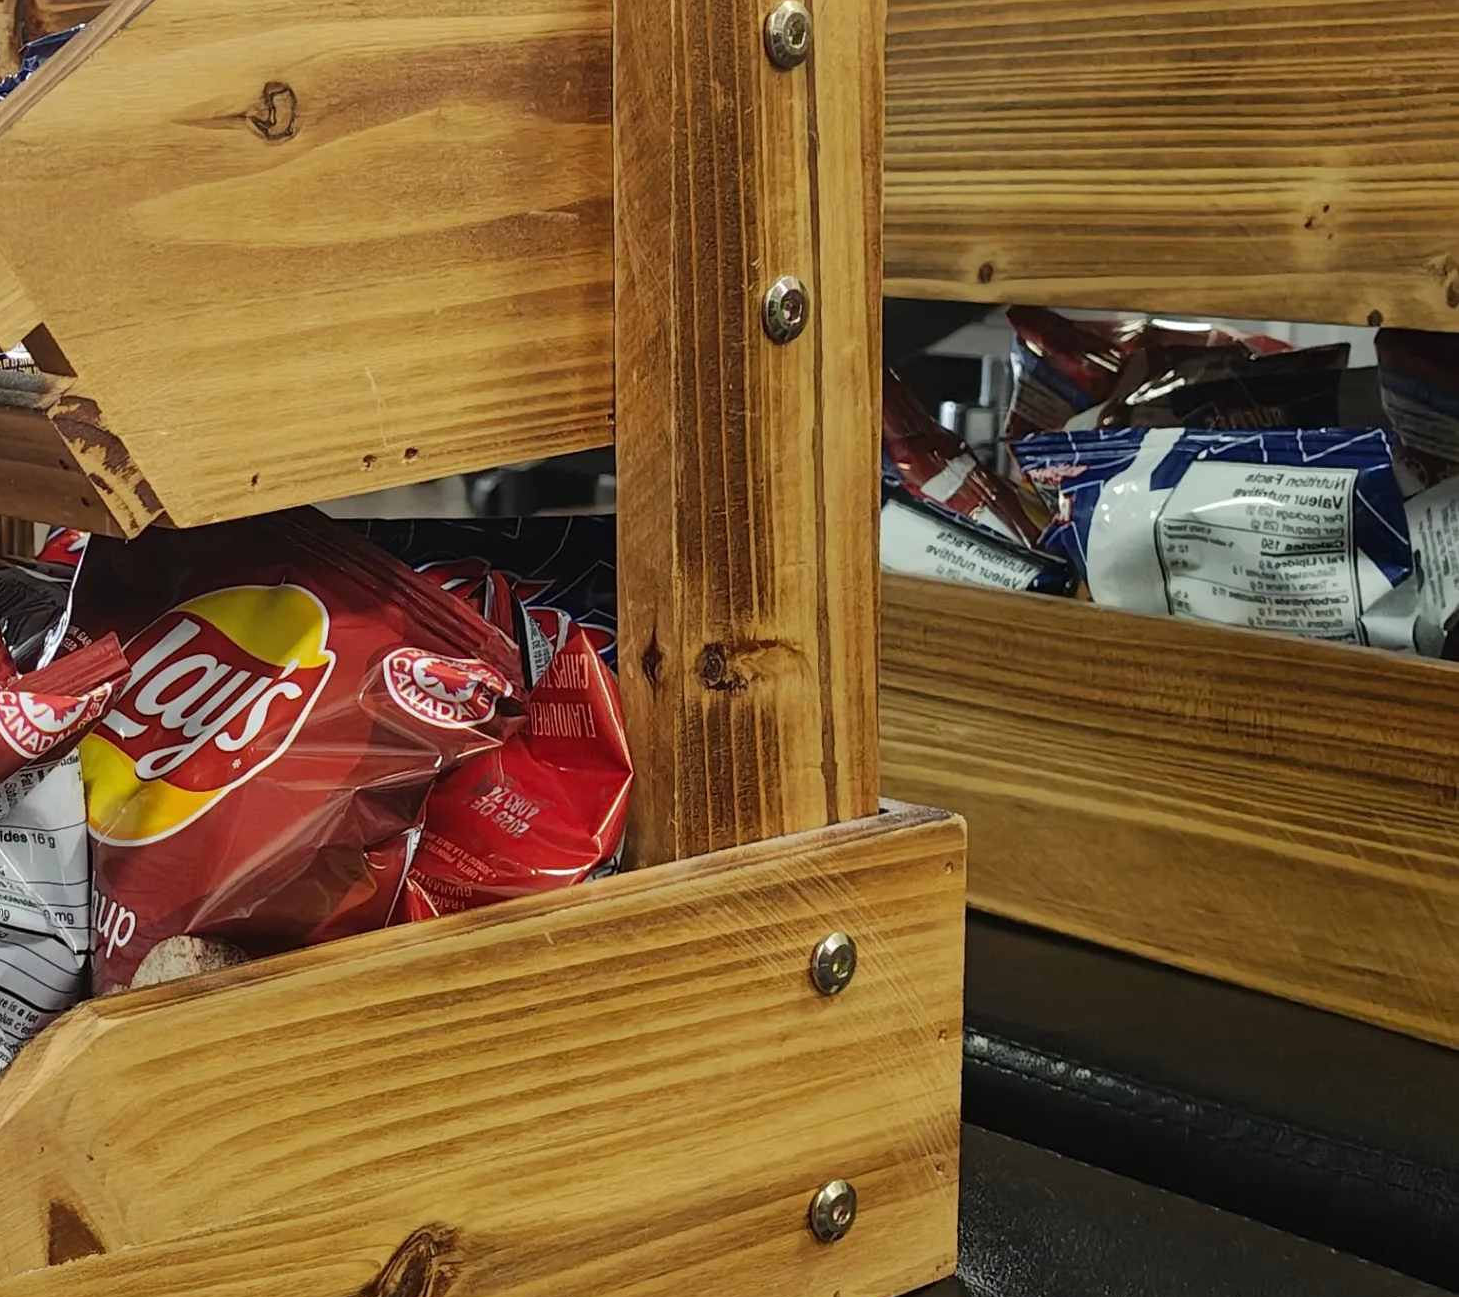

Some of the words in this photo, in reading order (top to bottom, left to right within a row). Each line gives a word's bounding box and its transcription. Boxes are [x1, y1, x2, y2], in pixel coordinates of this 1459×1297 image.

[553, 654, 589, 689] CHIPS
[102, 618, 303, 780] Lay's
[531, 703, 597, 738] FLAVOURED
[492, 810, 531, 839] 2025
[31, 832, 46, 845] 16
[47, 836, 56, 849] g
[54, 911, 75, 924] mg
[7, 999, 18, 1013] is
[17, 1007, 25, 1017] a
[25, 1011, 40, 1024] lot
